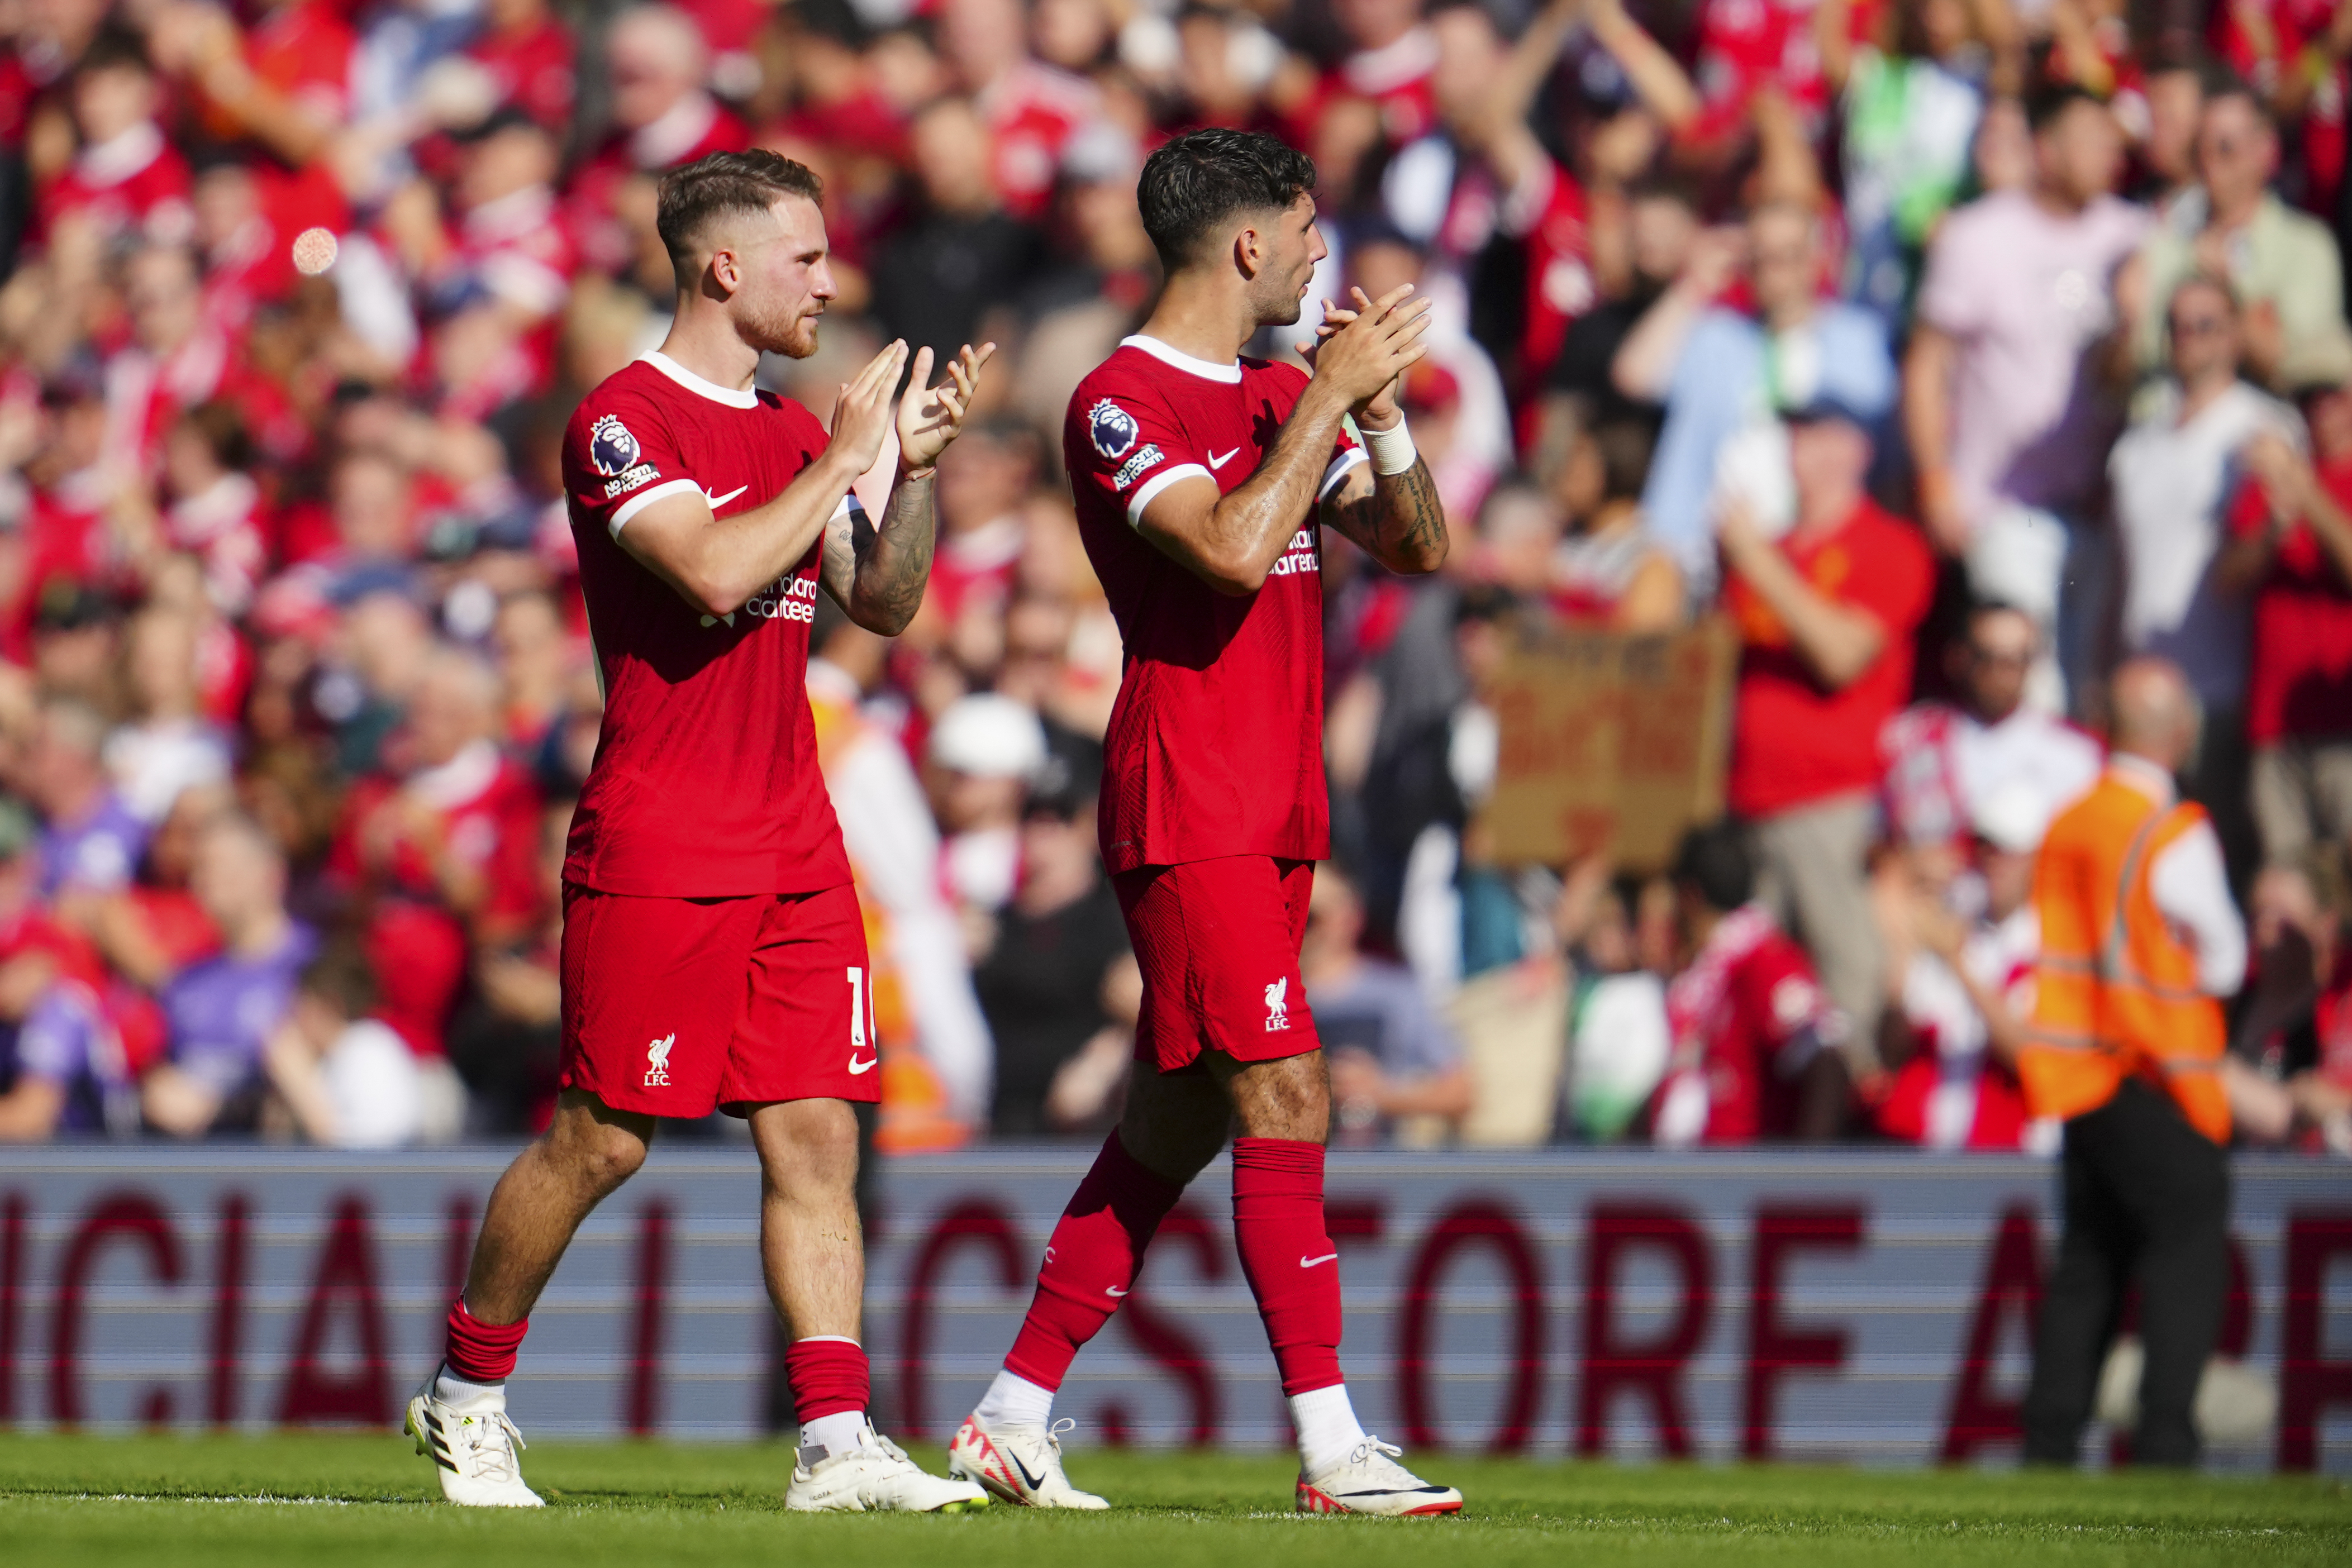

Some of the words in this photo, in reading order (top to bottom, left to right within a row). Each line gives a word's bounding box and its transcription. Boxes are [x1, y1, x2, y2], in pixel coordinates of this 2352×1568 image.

[604, 479, 621, 494] No
[620, 464, 652, 485] room
[1112, 469, 1128, 487] No
[1123, 447, 1155, 473] room
[1129, 452, 1165, 480] racism
[622, 471, 662, 493] racism
